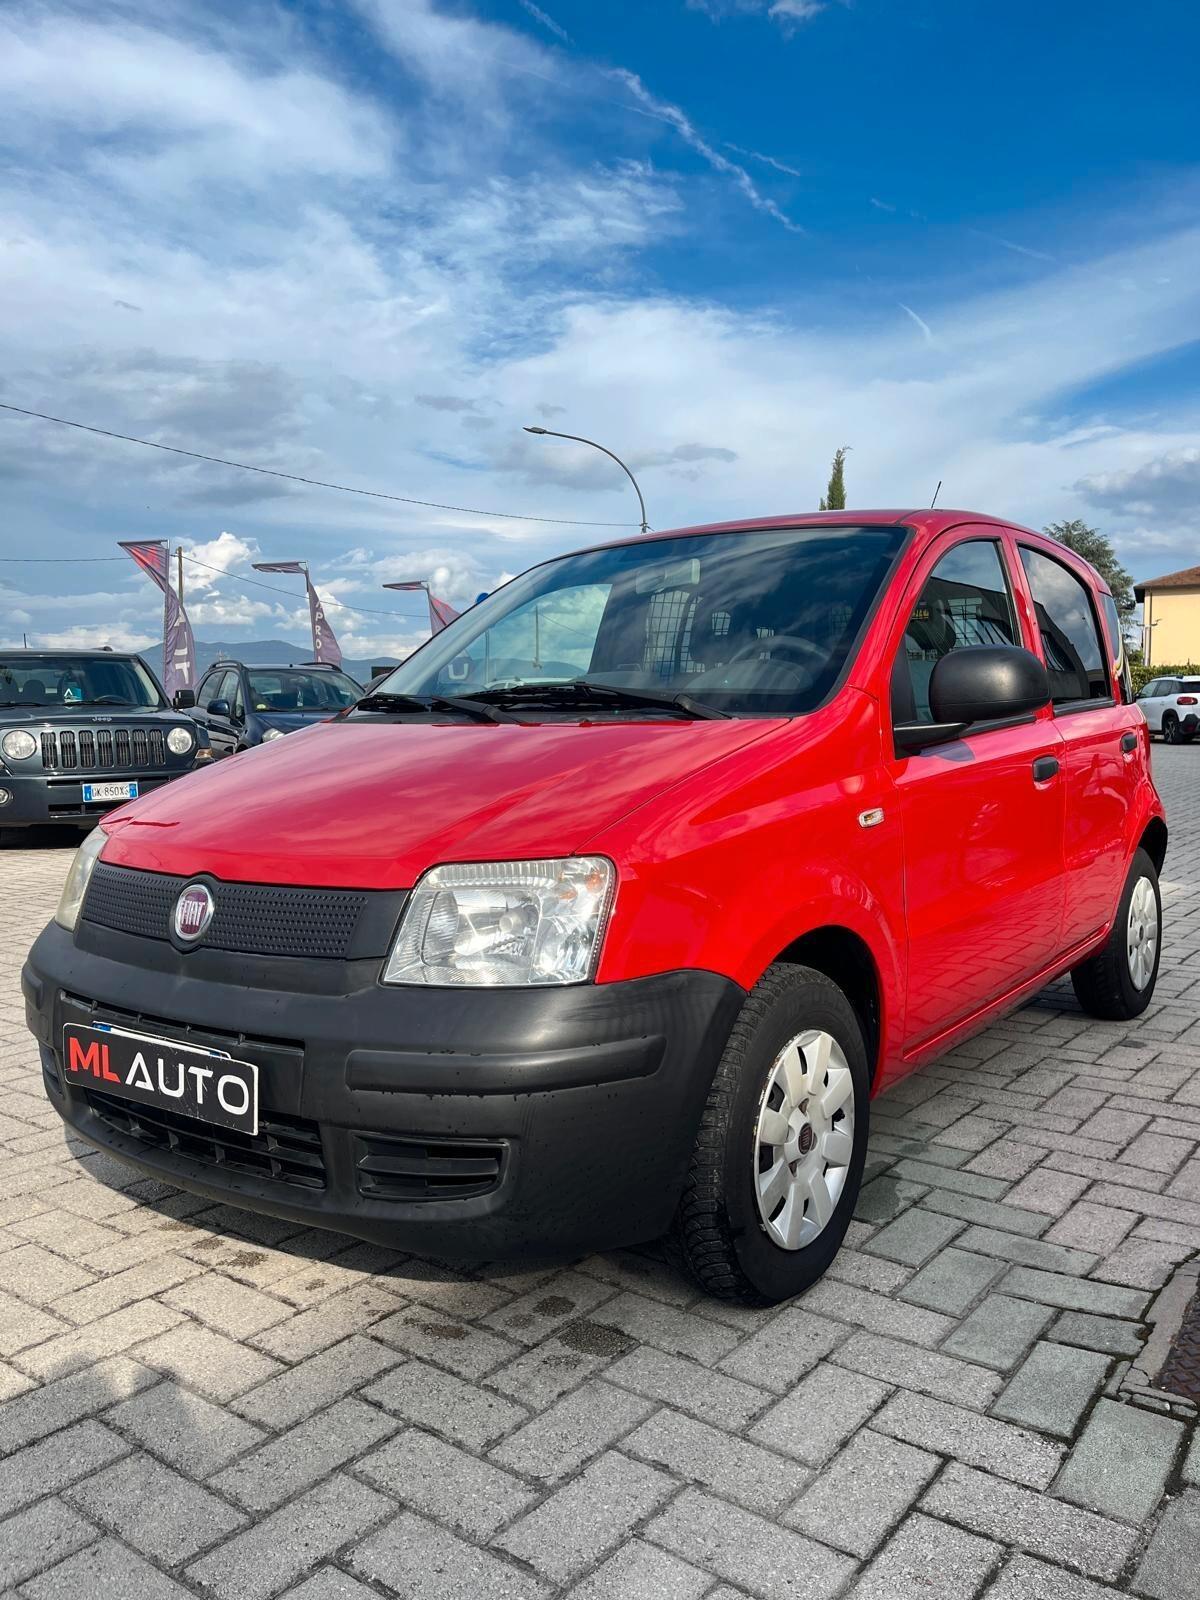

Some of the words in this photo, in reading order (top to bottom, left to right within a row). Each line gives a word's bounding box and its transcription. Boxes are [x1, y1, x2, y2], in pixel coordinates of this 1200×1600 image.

[180, 900, 205, 926] FIAT
[69, 1037, 121, 1083] ML
[125, 1052, 250, 1115] AUTO
